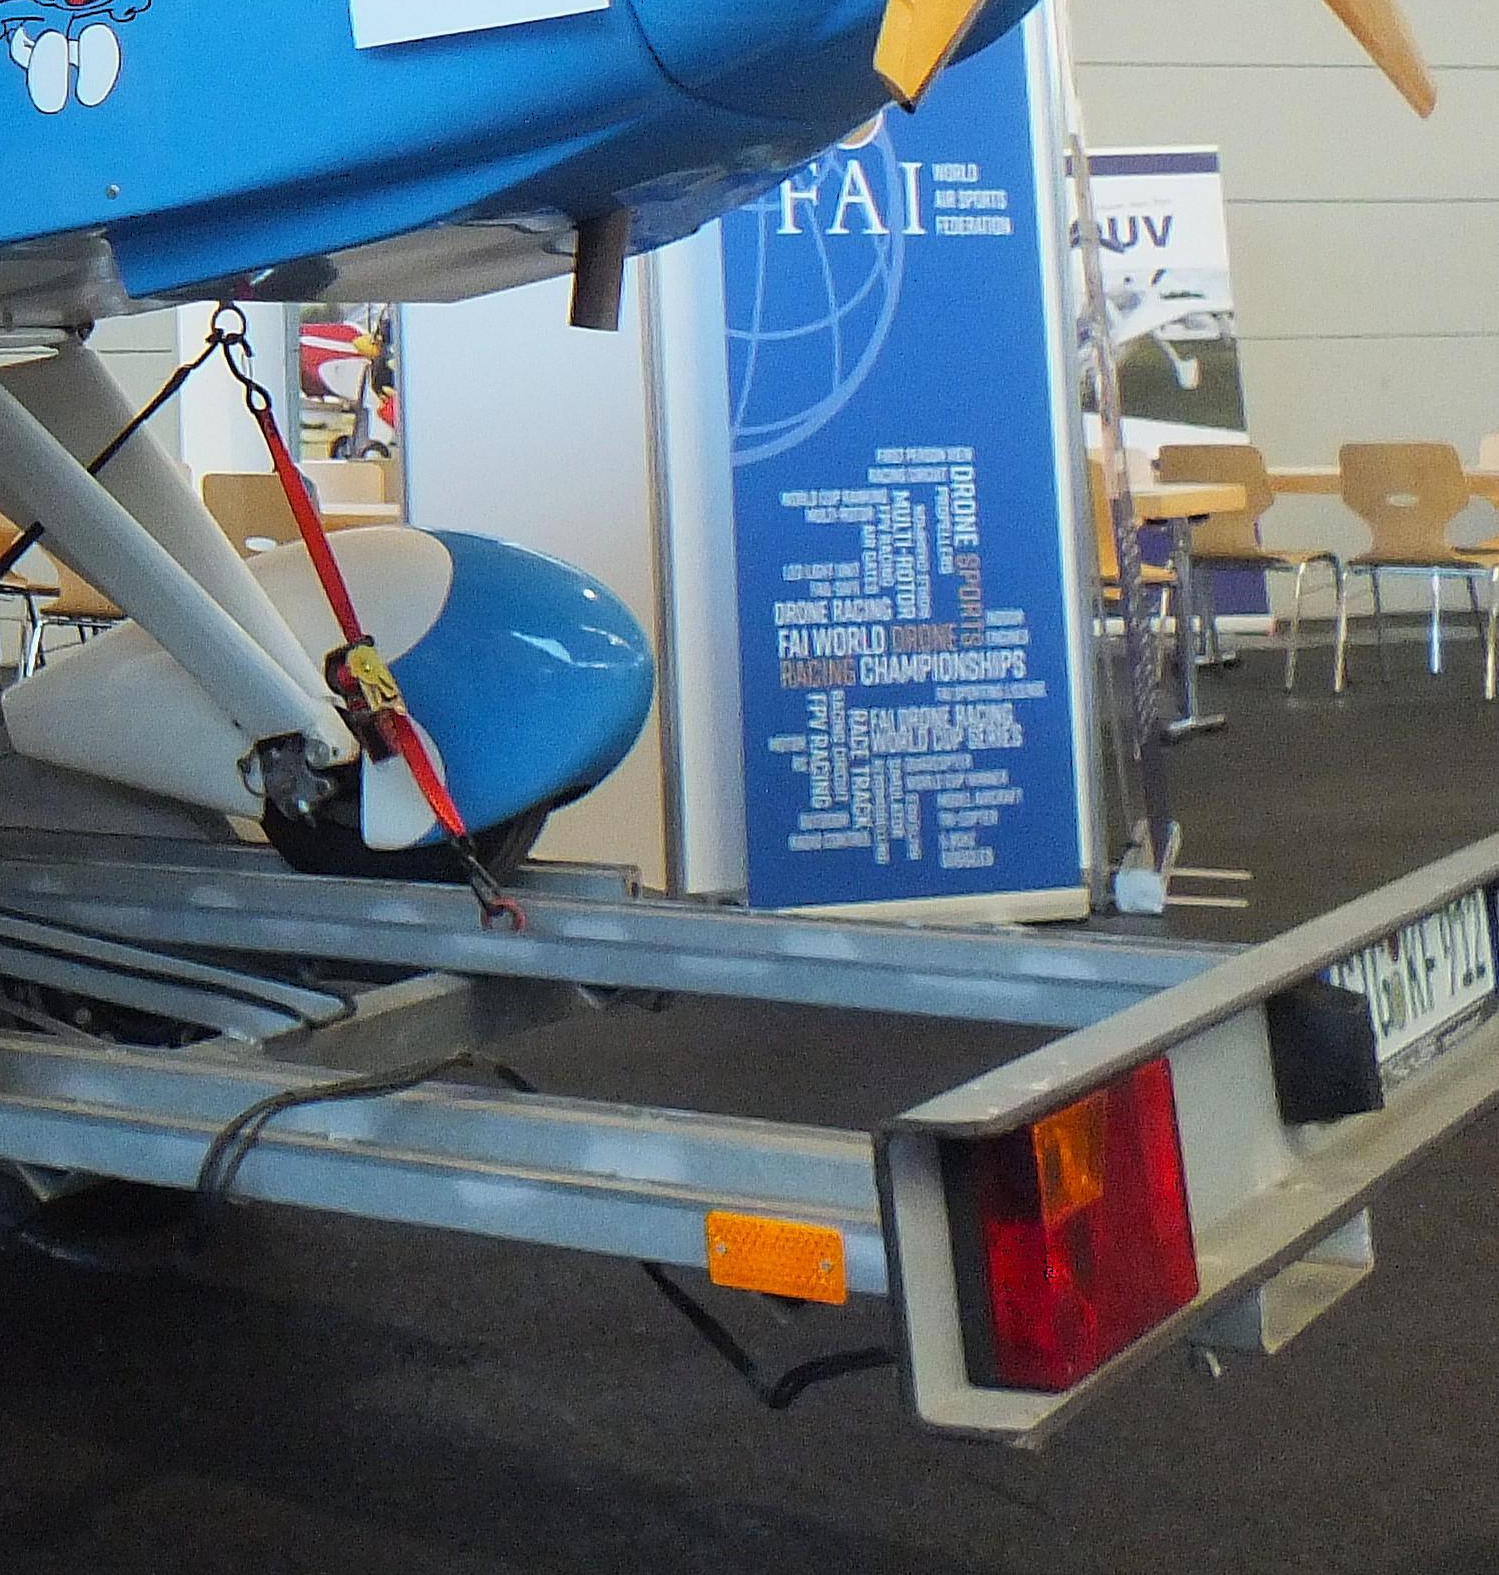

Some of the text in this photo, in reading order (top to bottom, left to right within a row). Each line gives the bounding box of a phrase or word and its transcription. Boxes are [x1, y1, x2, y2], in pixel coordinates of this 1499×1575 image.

[776, 160, 927, 235] FAI
[892, 489, 916, 619] MULTI-ROTOR
[950, 466, 983, 646] DRONE SPORTS
[774, 596, 893, 625] DRONE RACING
[778, 626, 810, 658] FAI
[811, 624, 886, 656] WORLD
[859, 650, 1026, 686] CHAMPIONSHIPS
